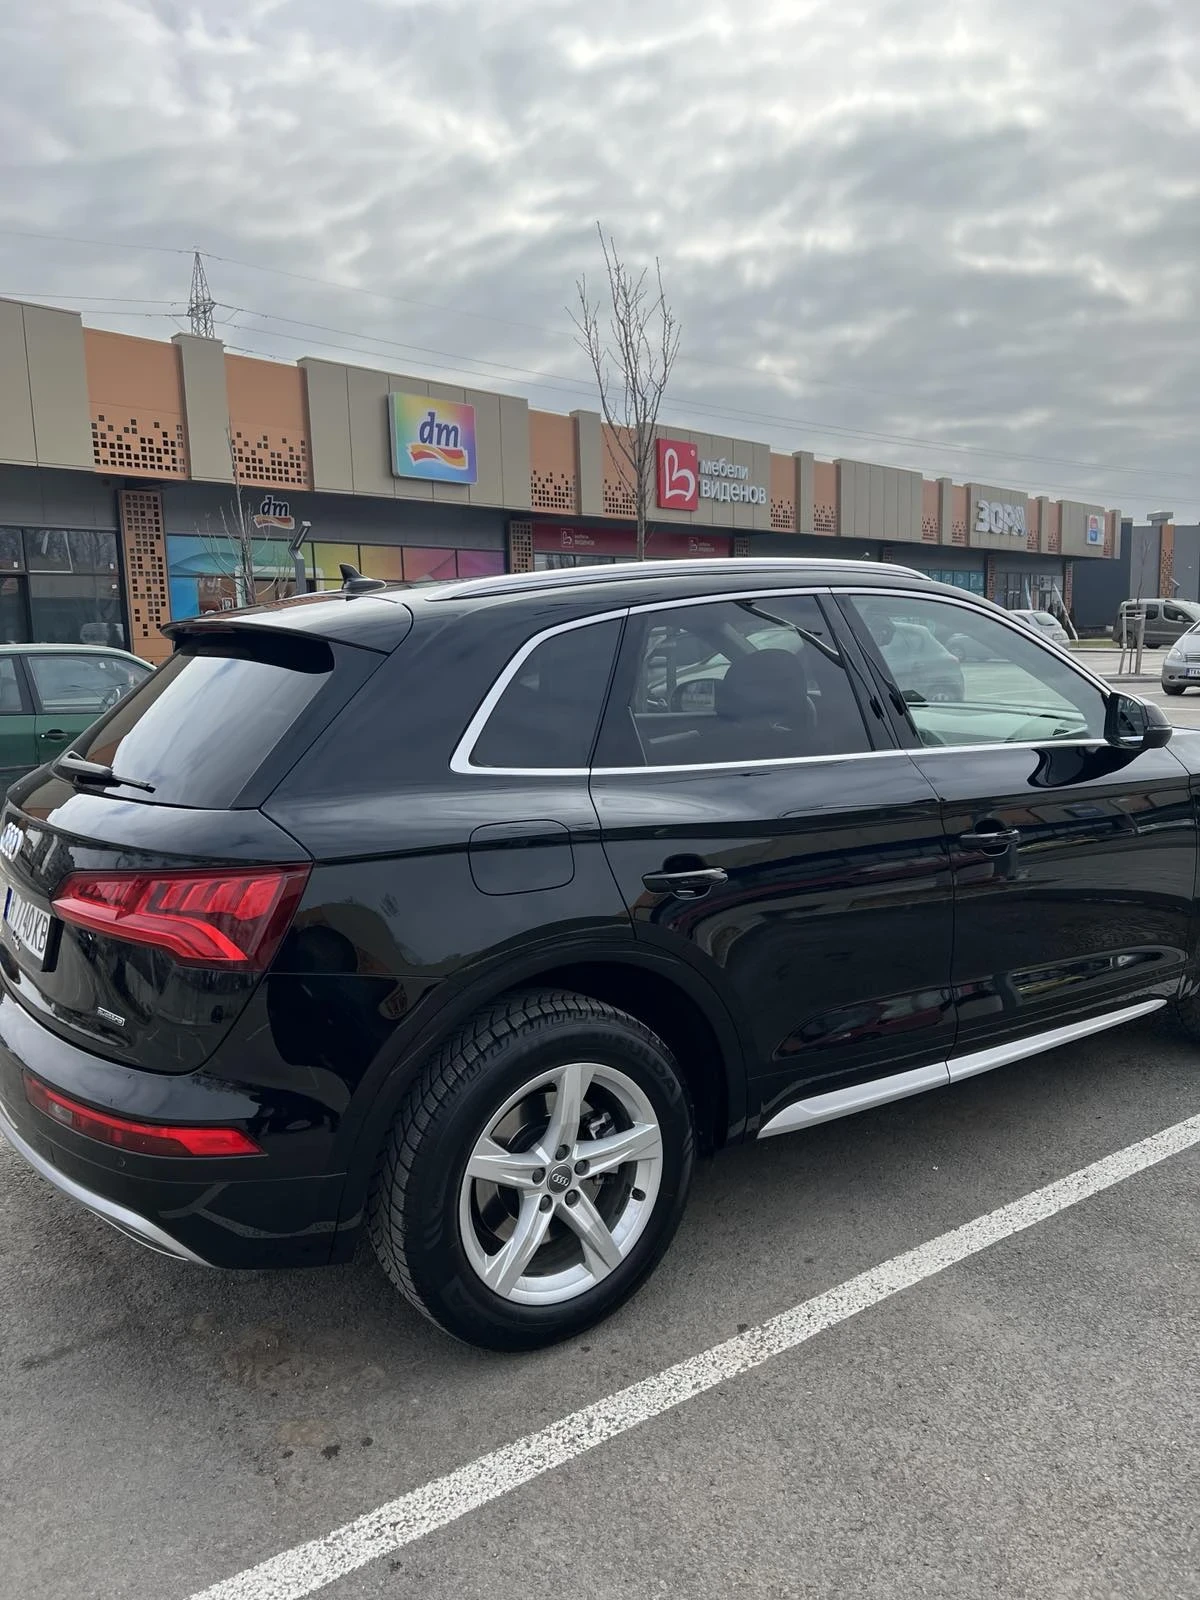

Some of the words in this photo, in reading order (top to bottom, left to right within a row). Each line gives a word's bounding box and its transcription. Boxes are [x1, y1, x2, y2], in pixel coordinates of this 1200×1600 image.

[419, 411, 459, 448] dm
[701, 458, 749, 480] мебели
[261, 496, 288, 516] dm
